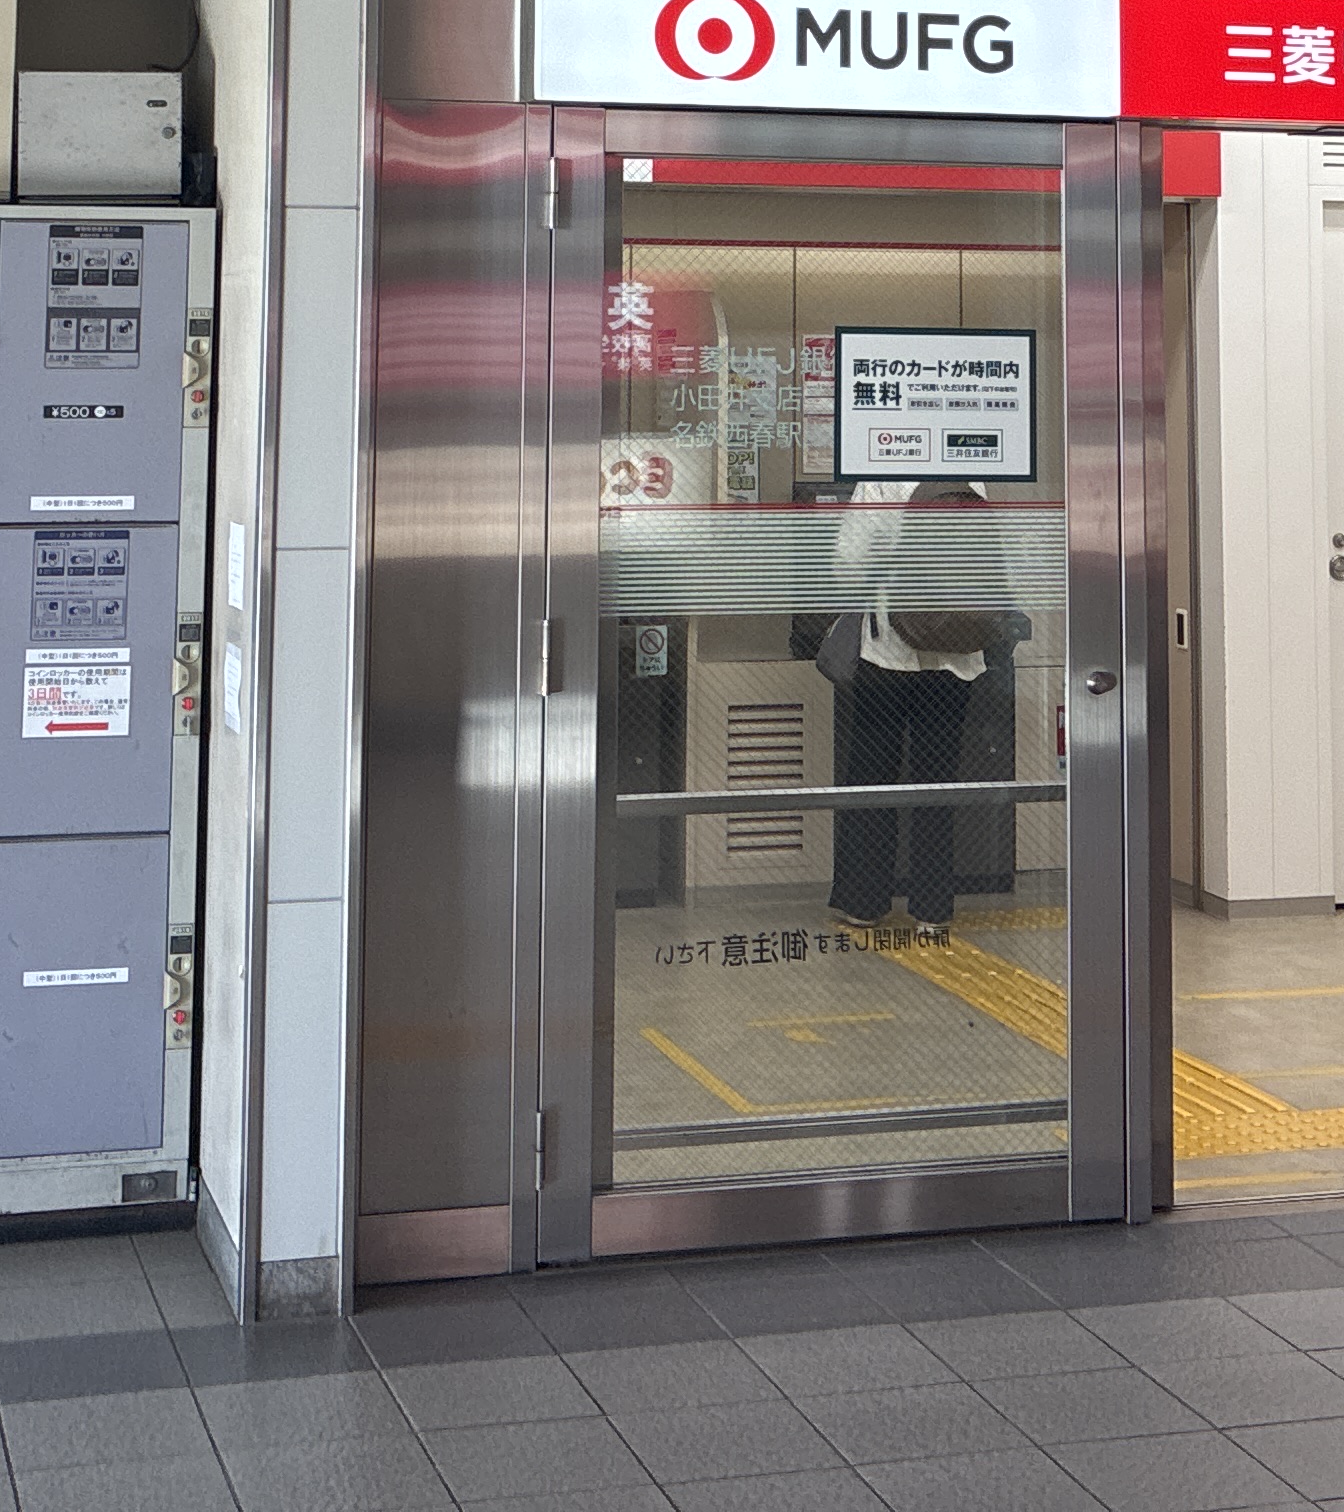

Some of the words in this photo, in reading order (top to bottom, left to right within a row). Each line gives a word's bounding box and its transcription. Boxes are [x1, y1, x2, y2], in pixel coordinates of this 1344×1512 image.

[795, 7, 1015, 74] MUFG
[853, 358, 1019, 379] 両行のカードが時間内
[853, 381, 902, 406] 無料
[670, 421, 802, 450] 名鉄西春駅
[894, 434, 923, 444] MUFG
